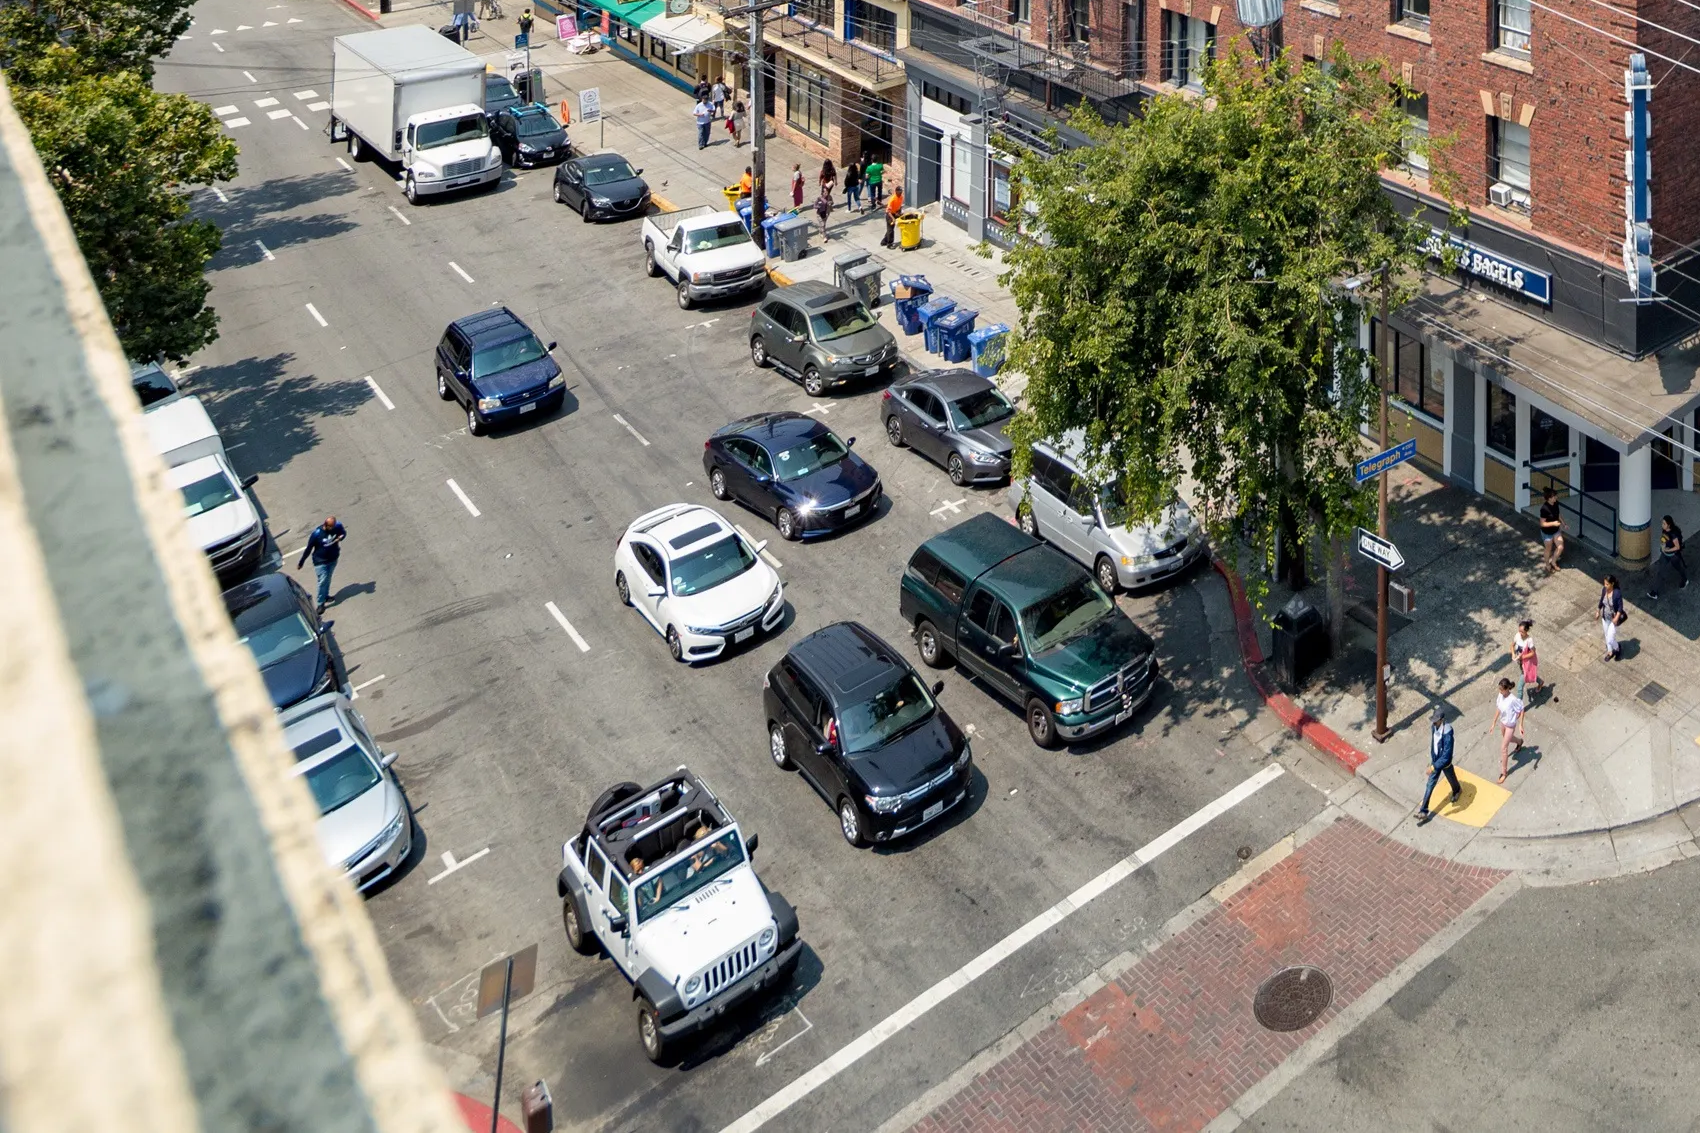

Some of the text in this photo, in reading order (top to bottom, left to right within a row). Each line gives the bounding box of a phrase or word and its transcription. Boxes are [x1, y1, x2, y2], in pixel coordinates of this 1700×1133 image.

[1472, 252, 1525, 290] BAGELS
[1360, 450, 1401, 477] Telegraph
[1362, 537, 1391, 561] ONE WAY
